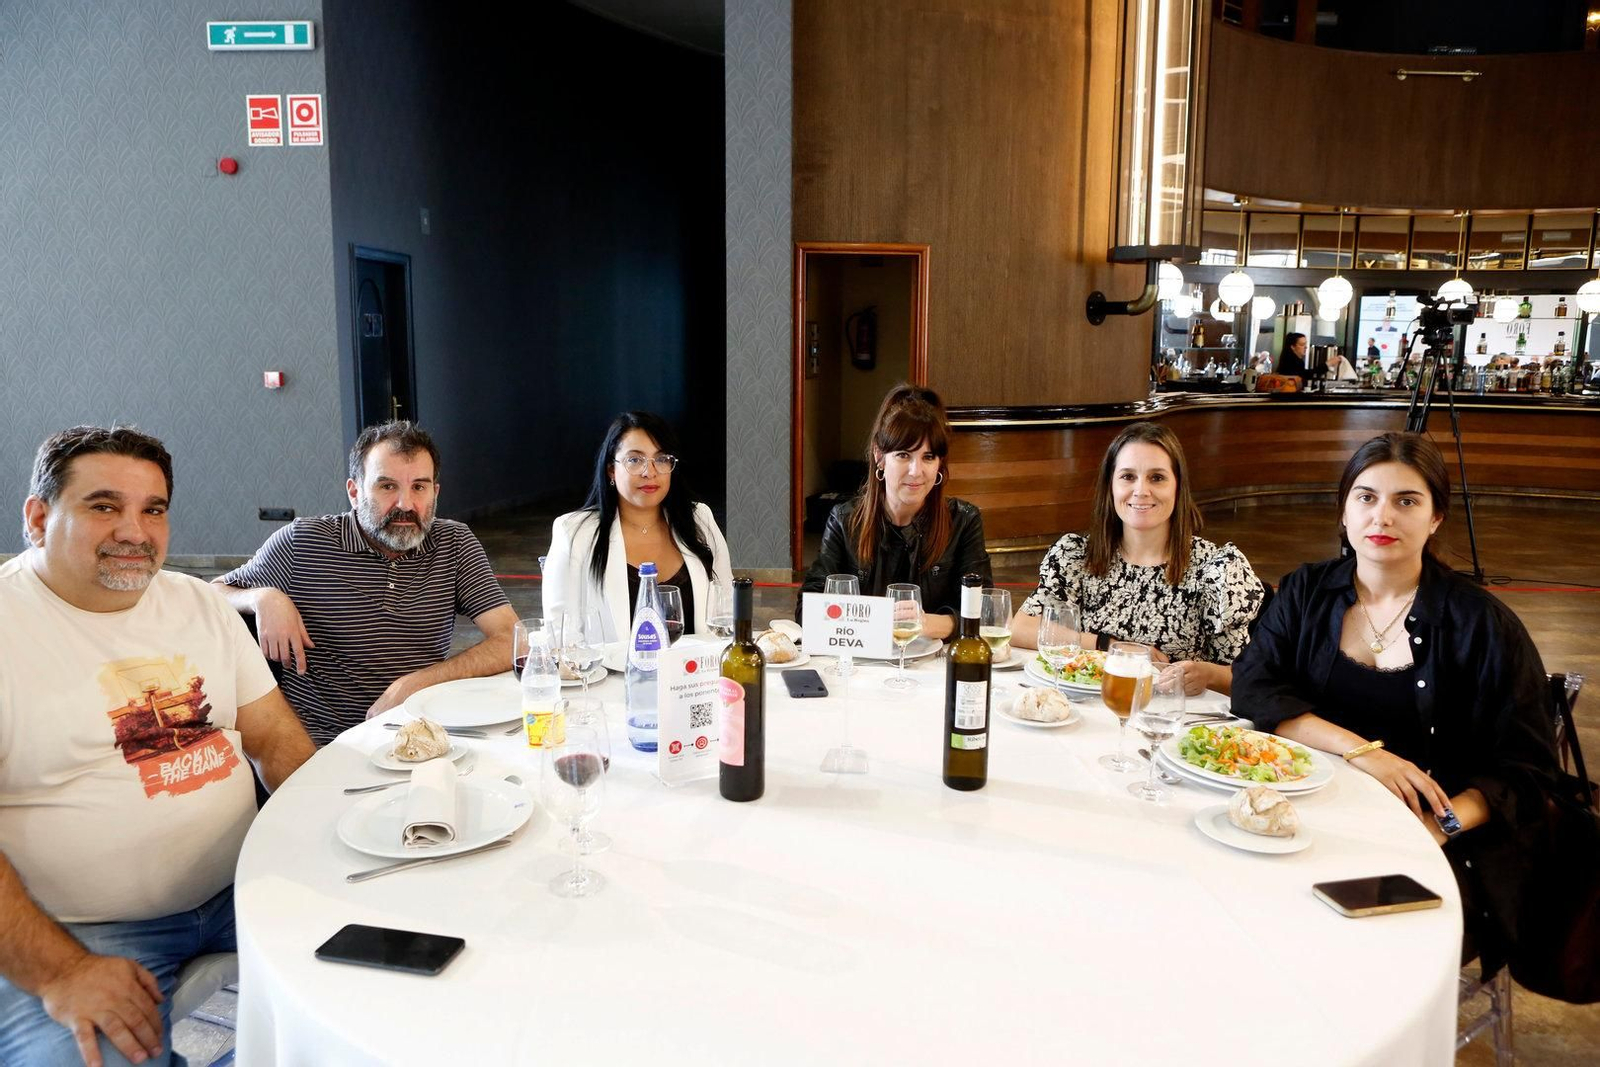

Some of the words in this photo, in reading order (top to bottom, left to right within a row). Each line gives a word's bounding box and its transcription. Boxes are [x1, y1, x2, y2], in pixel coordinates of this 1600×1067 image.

[846, 602, 871, 618] FORO
[835, 626, 855, 636] RÍO
[828, 637, 864, 648] DEVA
[670, 683, 687, 692] Haga
[159, 748, 203, 777] BACK
[204, 744, 218, 761] IN
[163, 768, 190, 786] THE
[193, 752, 226, 775] GAME
